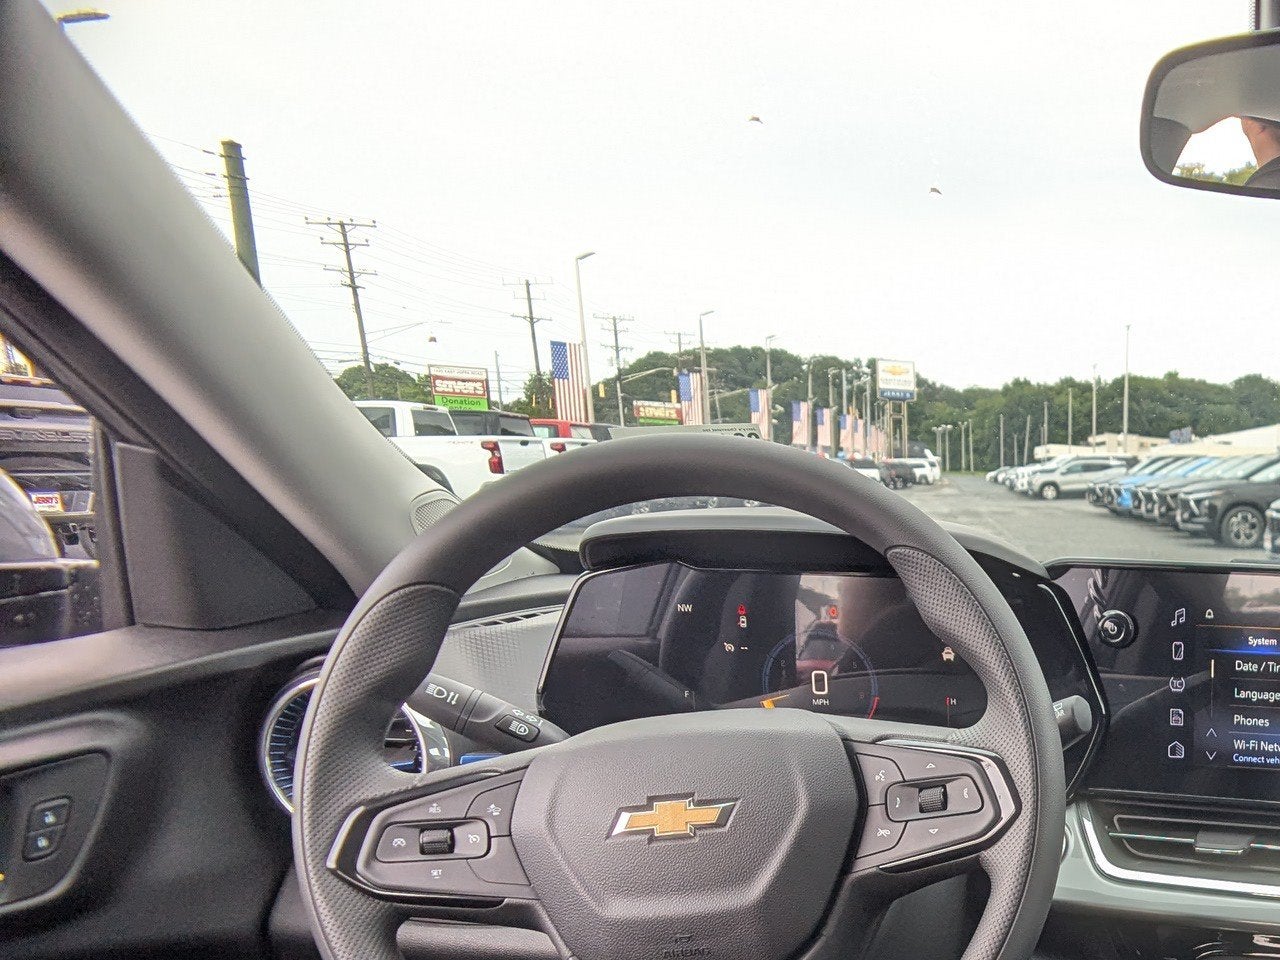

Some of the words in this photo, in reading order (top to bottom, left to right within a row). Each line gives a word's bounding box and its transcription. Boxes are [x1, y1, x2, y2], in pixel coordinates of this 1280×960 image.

[441, 396, 481, 406] Donation
[677, 604, 693, 612] NW
[1248, 636, 1278, 647] System
[1235, 660, 1258, 672] Date
[811, 670, 829, 695] 0
[684, 690, 690, 698] F
[1234, 687, 1280, 702] Language
[812, 698, 830, 706] MPH
[1233, 714, 1270, 727] Phones
[1233, 739, 1259, 750] Wi-Fi
[1233, 753, 1265, 763] Connect
